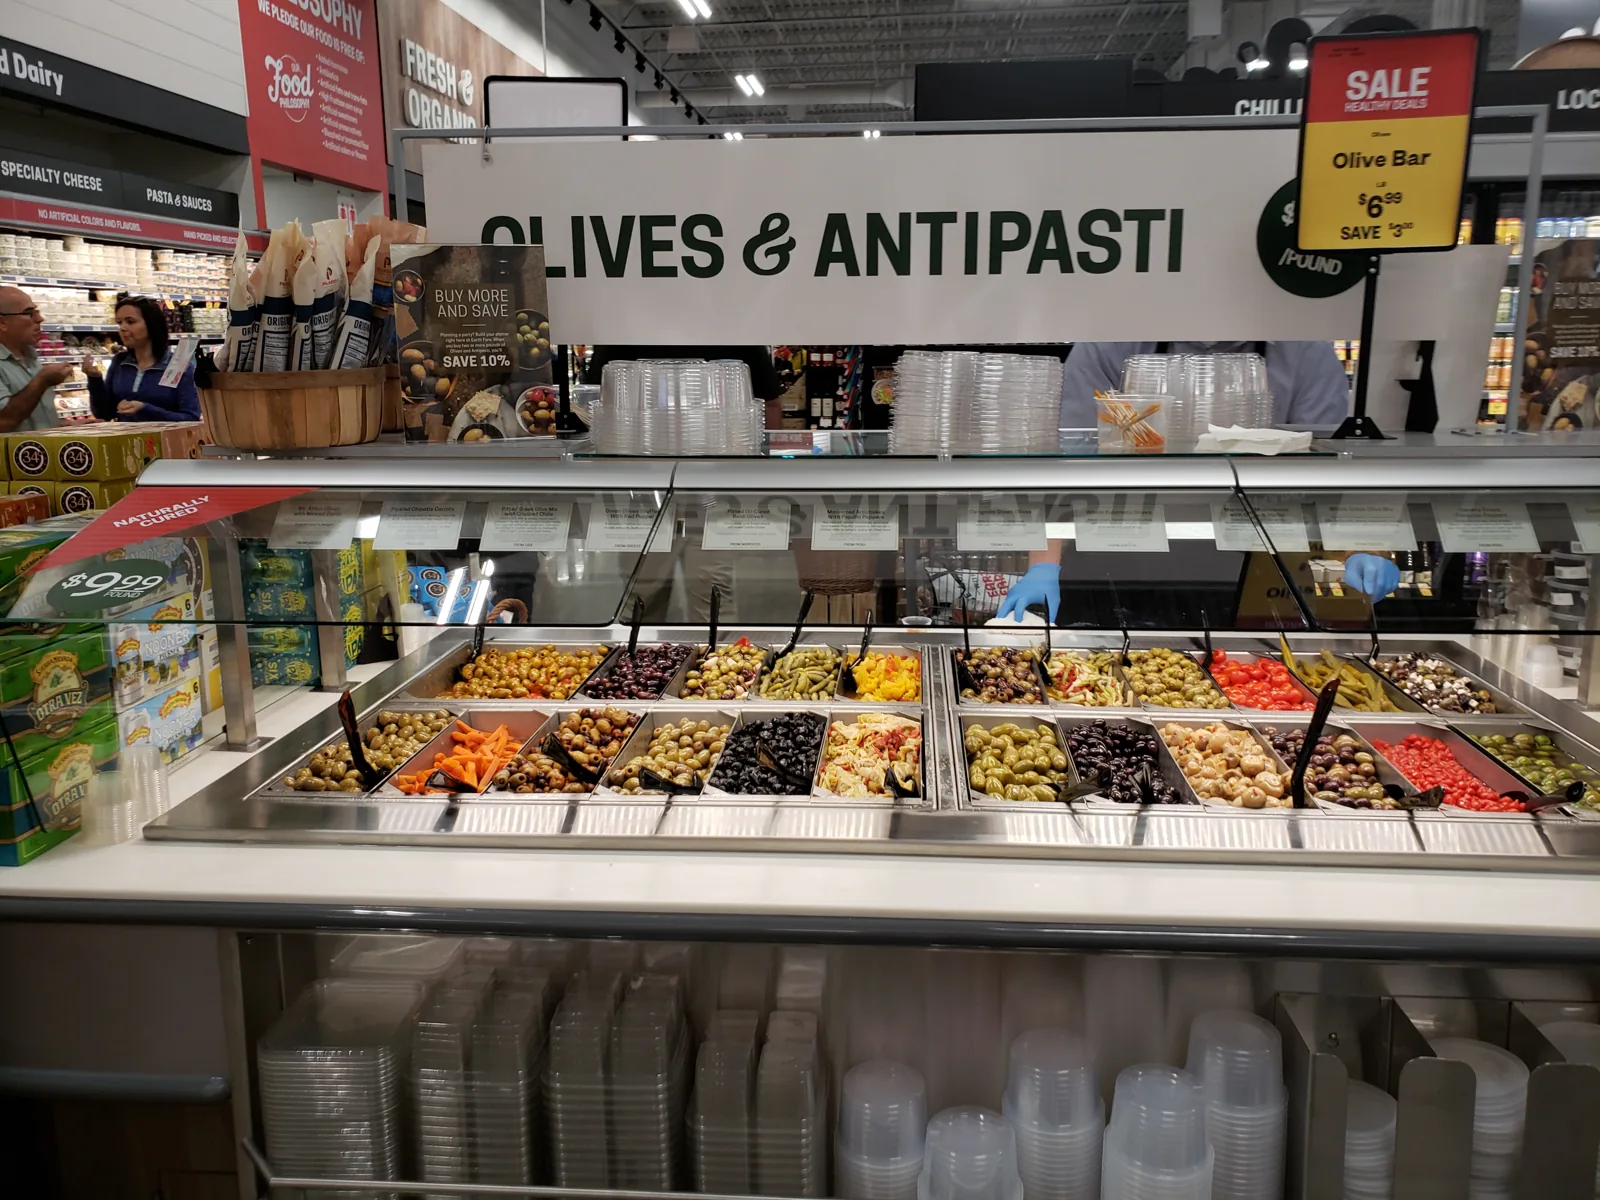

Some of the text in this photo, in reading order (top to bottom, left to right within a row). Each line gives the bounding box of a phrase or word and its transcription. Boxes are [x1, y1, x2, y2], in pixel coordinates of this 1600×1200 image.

[257, 0, 271, 16] WE
[270, 4, 300, 31] PLEDGE
[299, 19, 315, 40] OUR
[315, 28, 333, 48] FOOD
[333, 36, 341, 52] IS
[340, 41, 356, 60] FREE
[12, 52, 64, 97] Dairy
[265, 55, 315, 103] Food
[402, 38, 458, 101] FRESH
[459, 69, 475, 107] &
[1345, 66, 1432, 101] SALE
[1344, 98, 1429, 113] HEALTHY DEALS
[1556, 88, 1600, 110] LOC
[405, 87, 478, 145] ORGANIC
[1332, 149, 1432, 169] Olive Bar
[0, 160, 103, 192] SPECIALTY CHEESE
[146, 187, 213, 212] PASTA & SAUCES
[38, 208, 49, 219] NO
[48, 209, 81, 224] ARTIFICIAL
[81, 214, 104, 227] COLORS
[104, 217, 117, 229] AND
[183, 230, 198, 240] HAND
[742, 211, 797, 276] &
[813, 208, 1184, 277] ANTIPASTI
[1340, 225, 1382, 240] SAVE
[1278, 248, 1343, 276] /POUND
[434, 288, 509, 303] BUY MORE
[437, 303, 509, 318] AND SAVE
[443, 355, 511, 367] SAVE 10%
[113, 495, 209, 528] NATURALLY
[140, 507, 198, 528] CURED
[103, 591, 140, 599] POUND
[185, 599, 191, 611] 6
[145, 628, 191, 658] NOONER
[193, 682, 199, 694] 6
[36, 691, 84, 722] OTRA VEZ
[51, 787, 79, 816] OTRA
